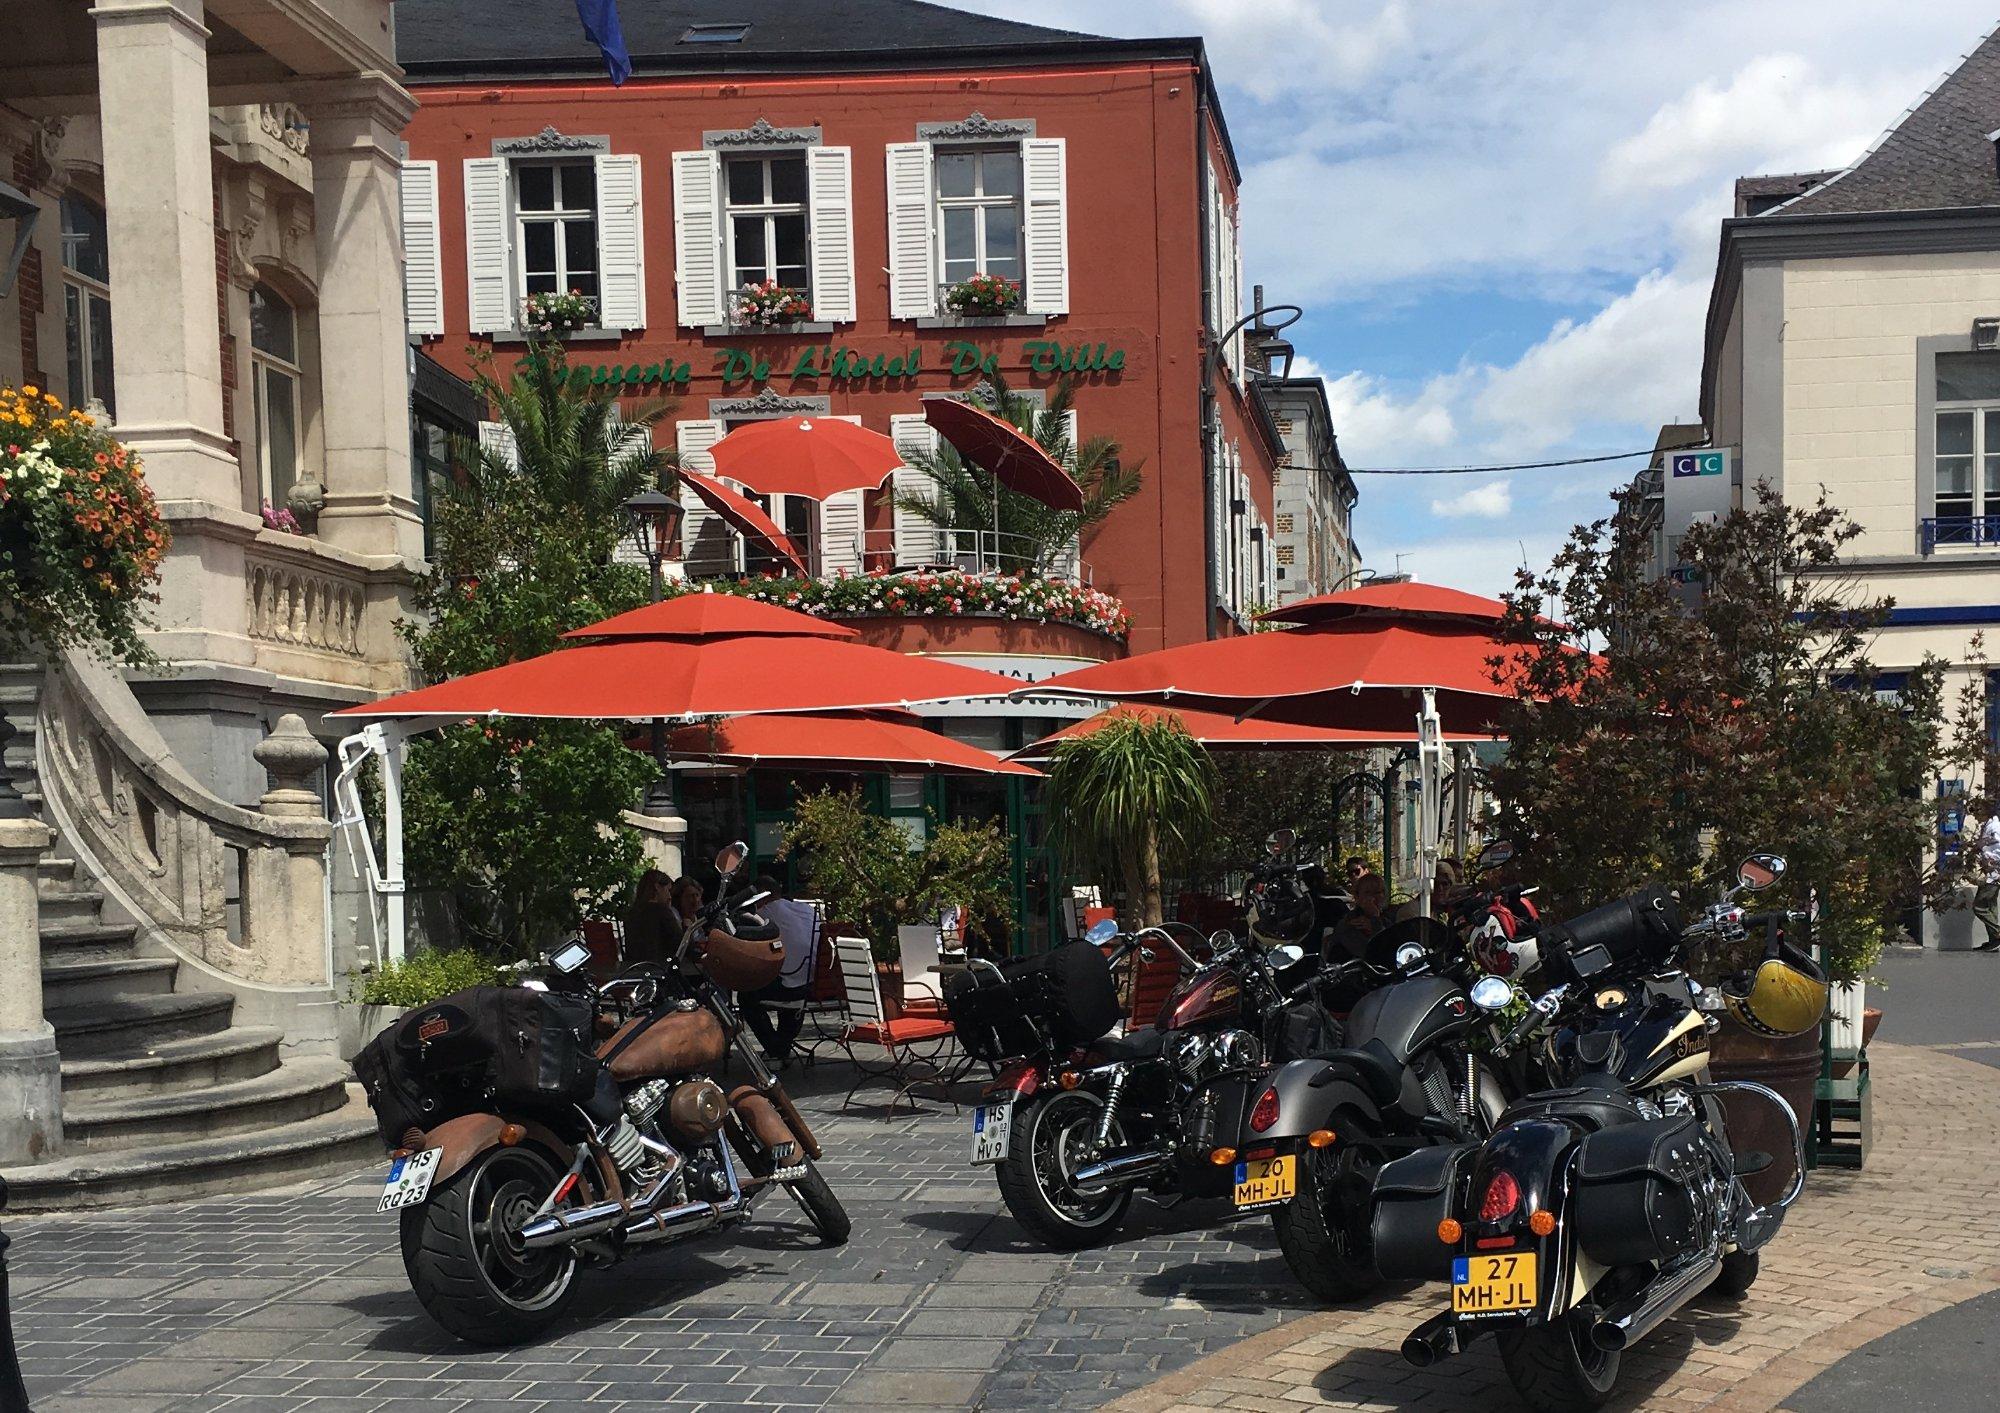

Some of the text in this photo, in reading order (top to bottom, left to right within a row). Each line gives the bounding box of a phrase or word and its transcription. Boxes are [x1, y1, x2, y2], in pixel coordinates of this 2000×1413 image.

[714, 347, 769, 382] De
[1022, 341, 1126, 374] Ville
[1676, 455, 1720, 475] CIC
[989, 1105, 1004, 1123] HS
[409, 1151, 433, 1170] HS
[978, 1142, 1002, 1160] MV 9
[1260, 1159, 1283, 1178] 20
[404, 1185, 426, 1204] 23
[1238, 1179, 1291, 1202] MH-JL
[1488, 1257, 1518, 1280] 27
[1458, 1283, 1532, 1308] MH-JL
